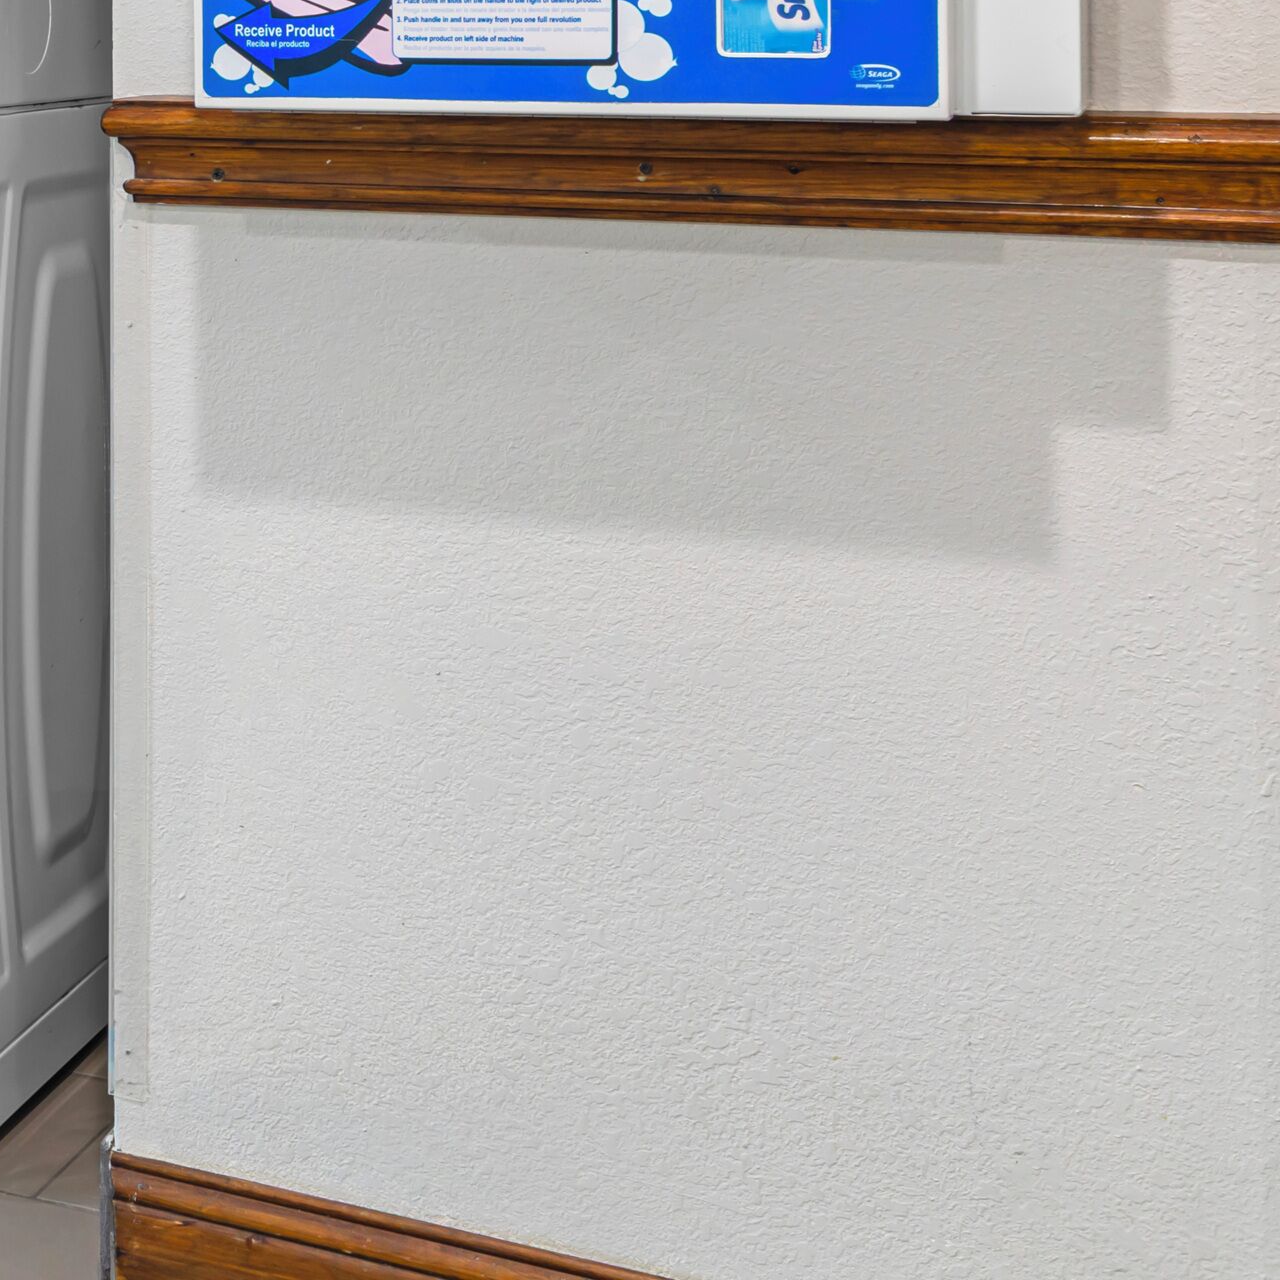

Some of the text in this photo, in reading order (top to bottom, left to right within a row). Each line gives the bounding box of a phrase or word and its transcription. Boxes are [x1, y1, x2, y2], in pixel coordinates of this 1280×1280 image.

[234, 23, 335, 37] Receive Product
[429, 35, 454, 43] product
[246, 39, 310, 49] Reciba el producto
[867, 70, 893, 78] SEAGA
